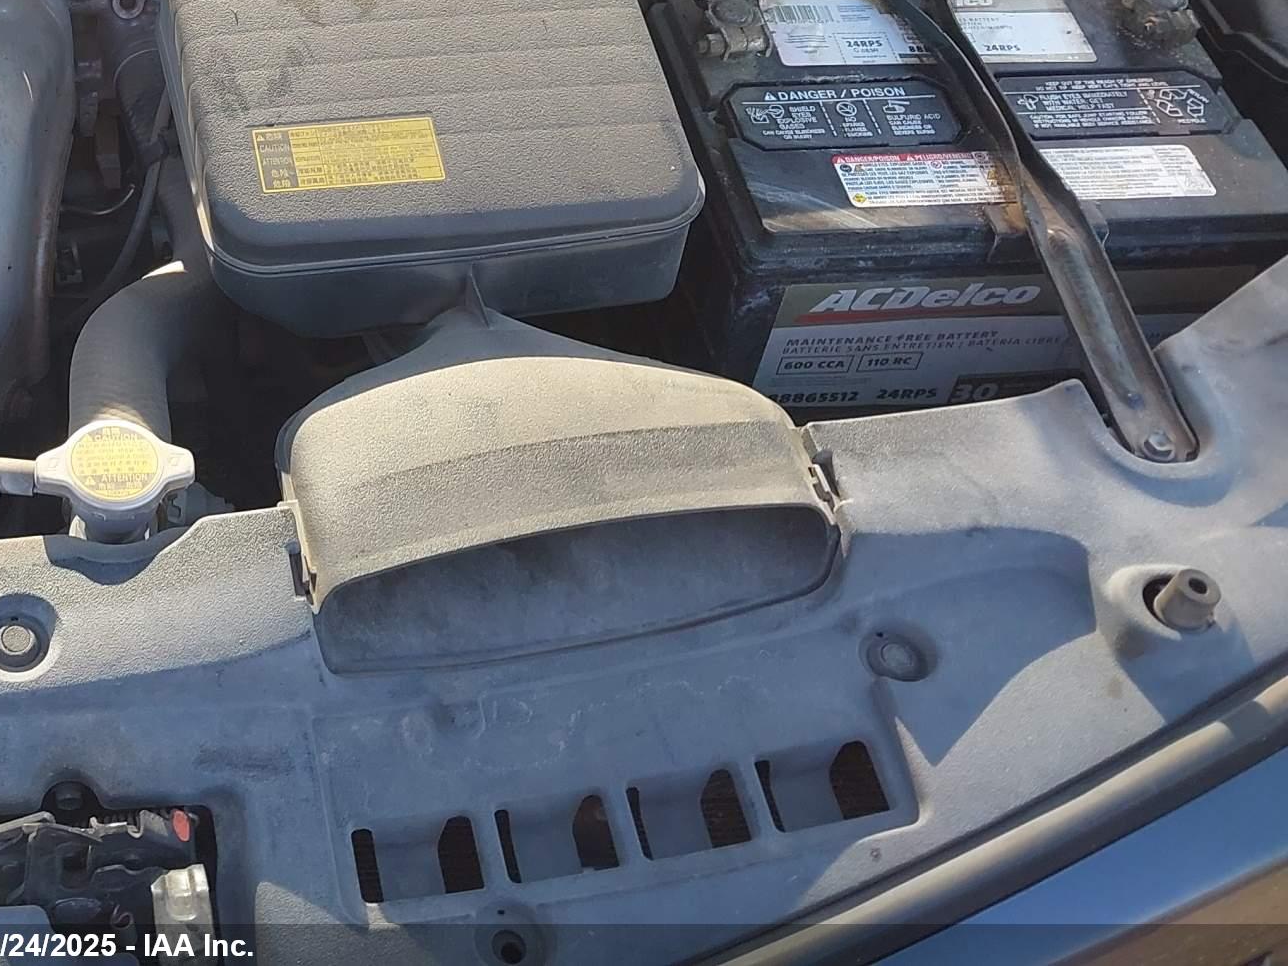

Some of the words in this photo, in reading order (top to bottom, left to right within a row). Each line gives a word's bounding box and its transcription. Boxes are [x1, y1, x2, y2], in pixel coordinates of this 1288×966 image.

[845, 39, 884, 48] 24RPS
[983, 44, 1021, 52] 24RPS
[777, 90, 837, 101] DANGER
[840, 89, 847, 99] /
[850, 86, 906, 97] POISON
[809, 283, 1041, 313] ACDelco
[786, 335, 890, 347] MAINTENANCE
[895, 333, 933, 343] FREE
[937, 330, 999, 341] BATTERY
[782, 344, 843, 354] BATTERIE
[847, 343, 880, 352] SANS
[883, 340, 953, 351] ENTRETIEN
[783, 360, 813, 371] 600
[817, 359, 845, 370] CCA
[866, 357, 889, 368] 110
[891, 355, 912, 366] RC
[875, 387, 937, 401] 24RPS
[954, 383, 1000, 402] 30
[95, 433, 138, 443] CAUTION
